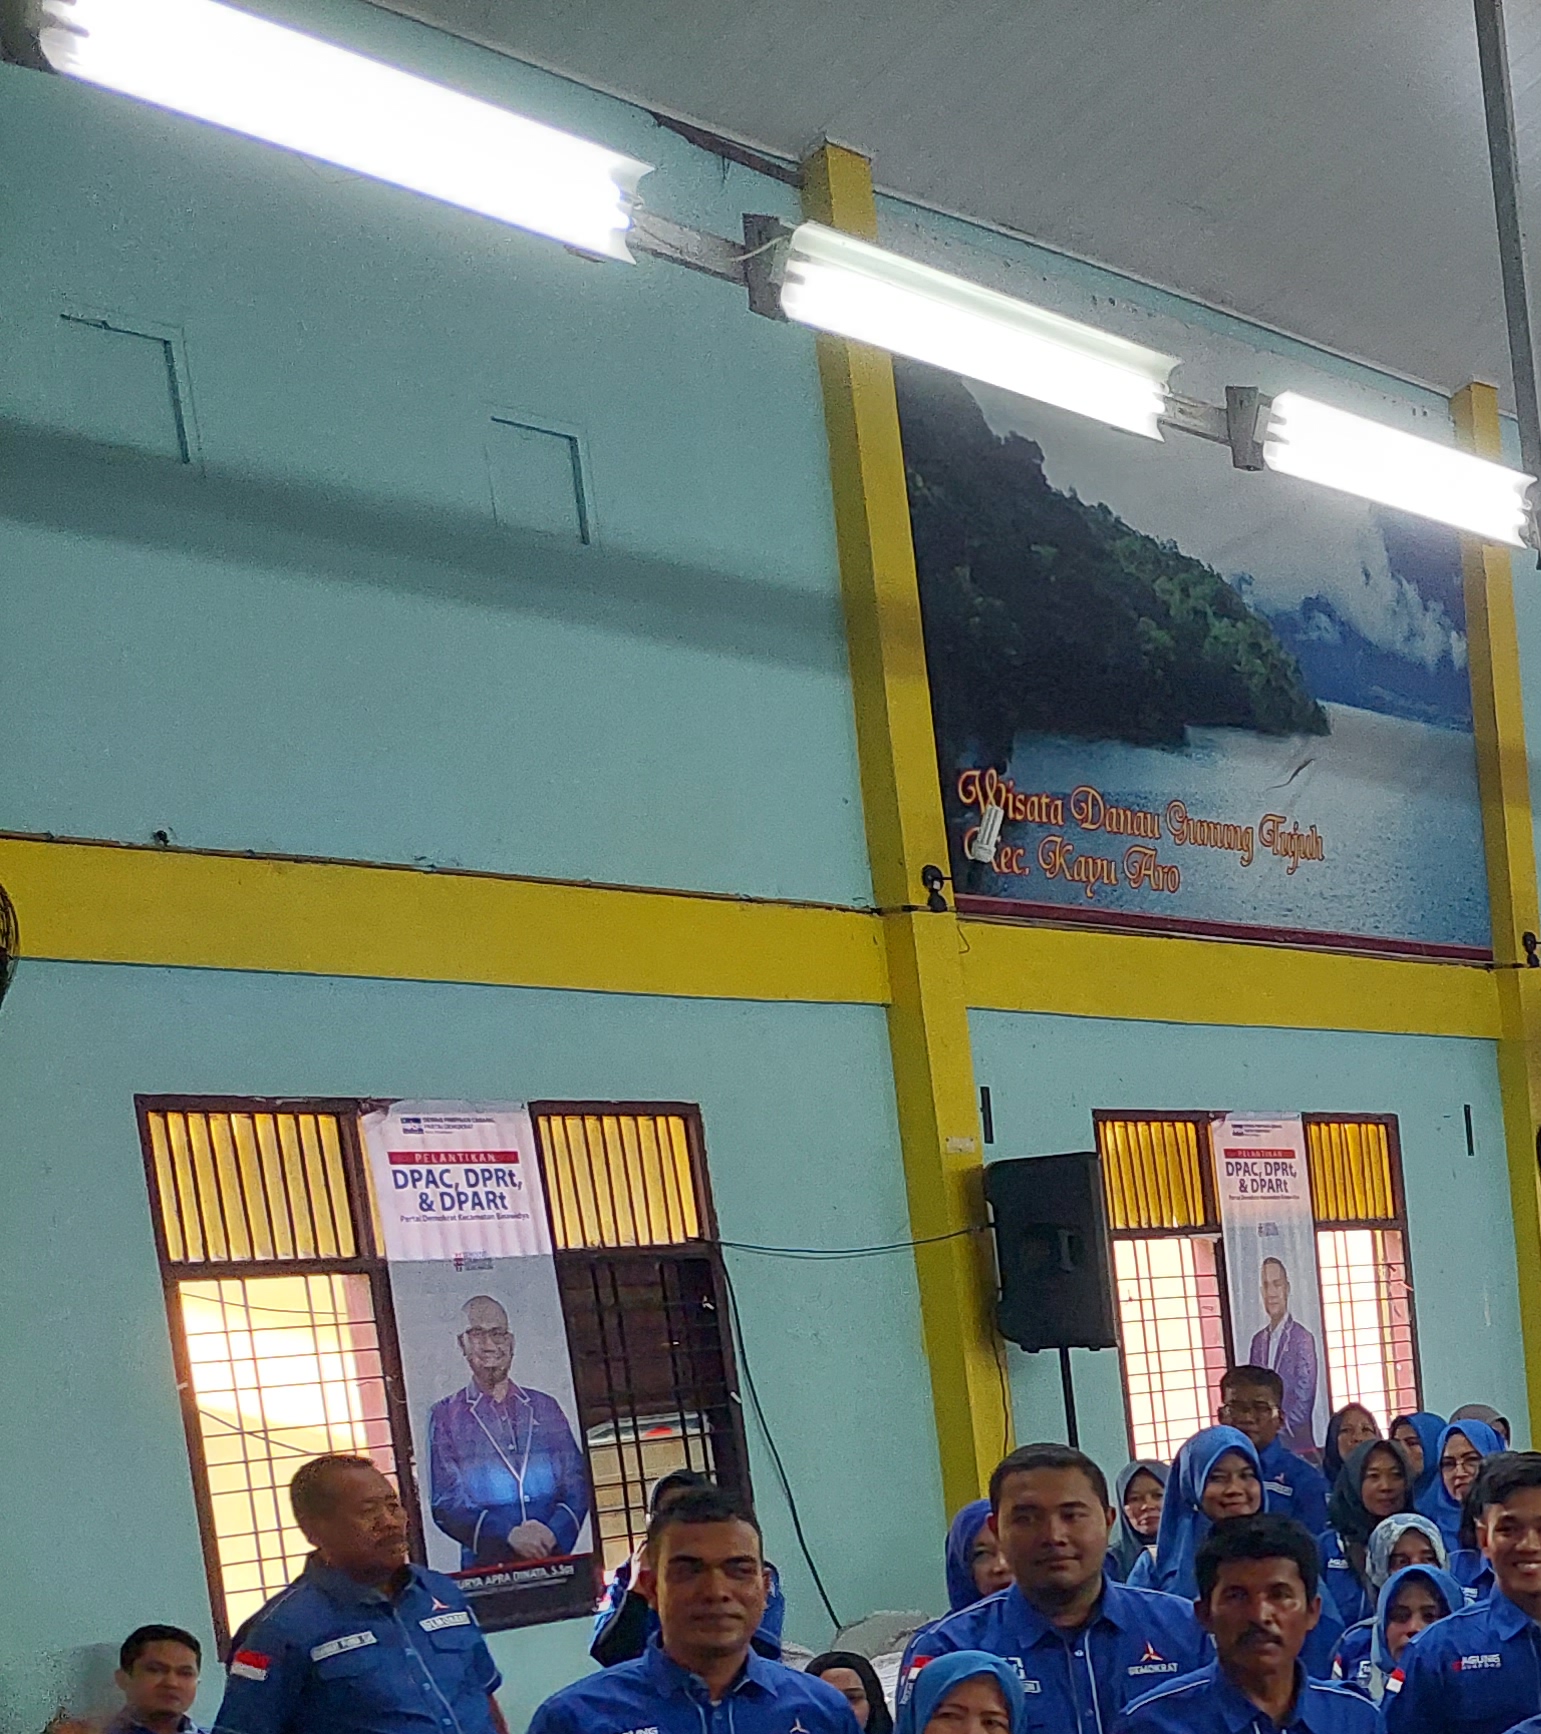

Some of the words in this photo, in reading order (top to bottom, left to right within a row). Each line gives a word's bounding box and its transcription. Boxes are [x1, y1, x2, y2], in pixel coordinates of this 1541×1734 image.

[957, 767, 1065, 826] Wisata
[1070, 784, 1162, 840] Danau
[1166, 799, 1254, 867] Gunung
[1258, 813, 1325, 874] Tujuh
[1037, 834, 1118, 898] Kayu
[1123, 844, 1180, 894] Aro
[414, 1152, 497, 1163] PELANTIKAN
[1225, 1161, 1263, 1178] DPAC,
[392, 1168, 460, 1191] DPAC,
[464, 1168, 522, 1190] DPRt,
[1238, 1178, 1249, 1193] &
[1250, 1178, 1289, 1194] DPARt
[418, 1192, 435, 1212] &
[439, 1191, 509, 1212] DPARt
[456, 1576, 483, 1590] URYA
